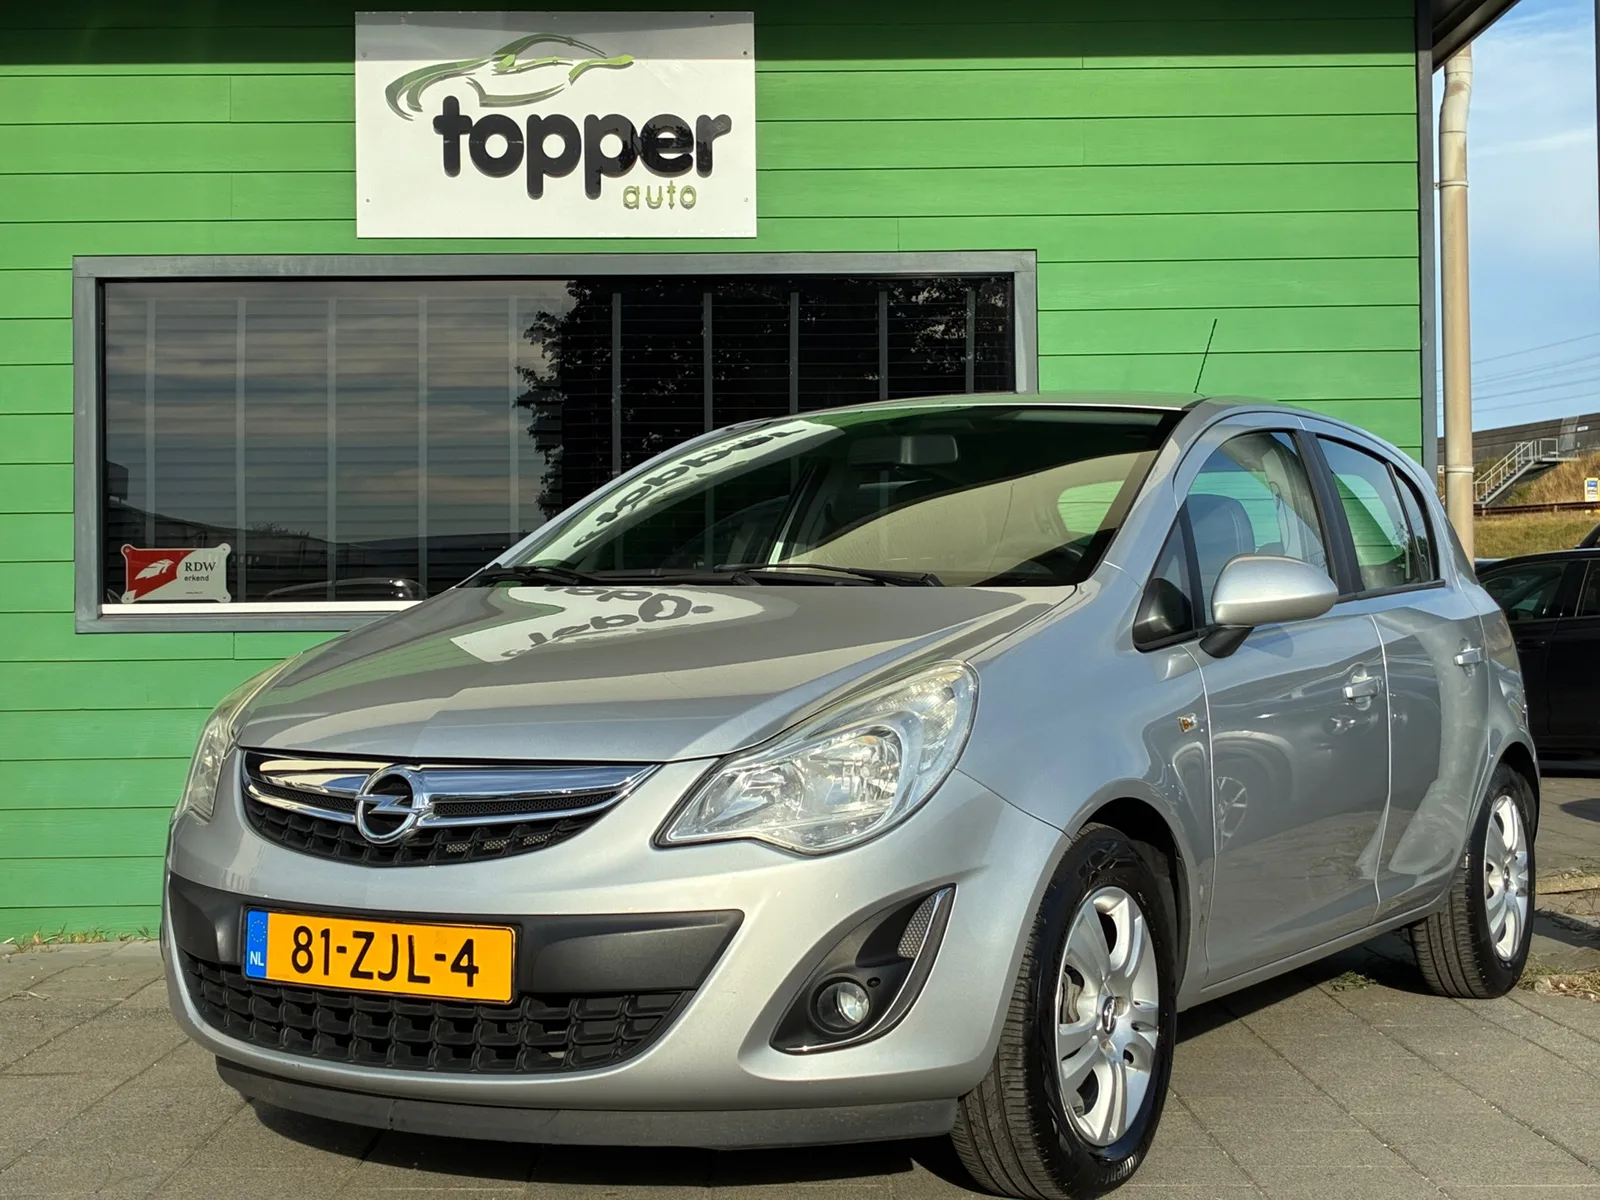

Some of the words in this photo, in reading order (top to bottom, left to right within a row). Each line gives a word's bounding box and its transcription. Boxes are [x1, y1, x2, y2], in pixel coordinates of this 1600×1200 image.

[433, 95, 732, 200] topper
[623, 180, 697, 210] auto
[184, 574, 210, 582] erkend
[185, 561, 216, 572] RDW
[250, 951, 265, 967] NL
[291, 925, 479, 988] 81-ZJL-4
